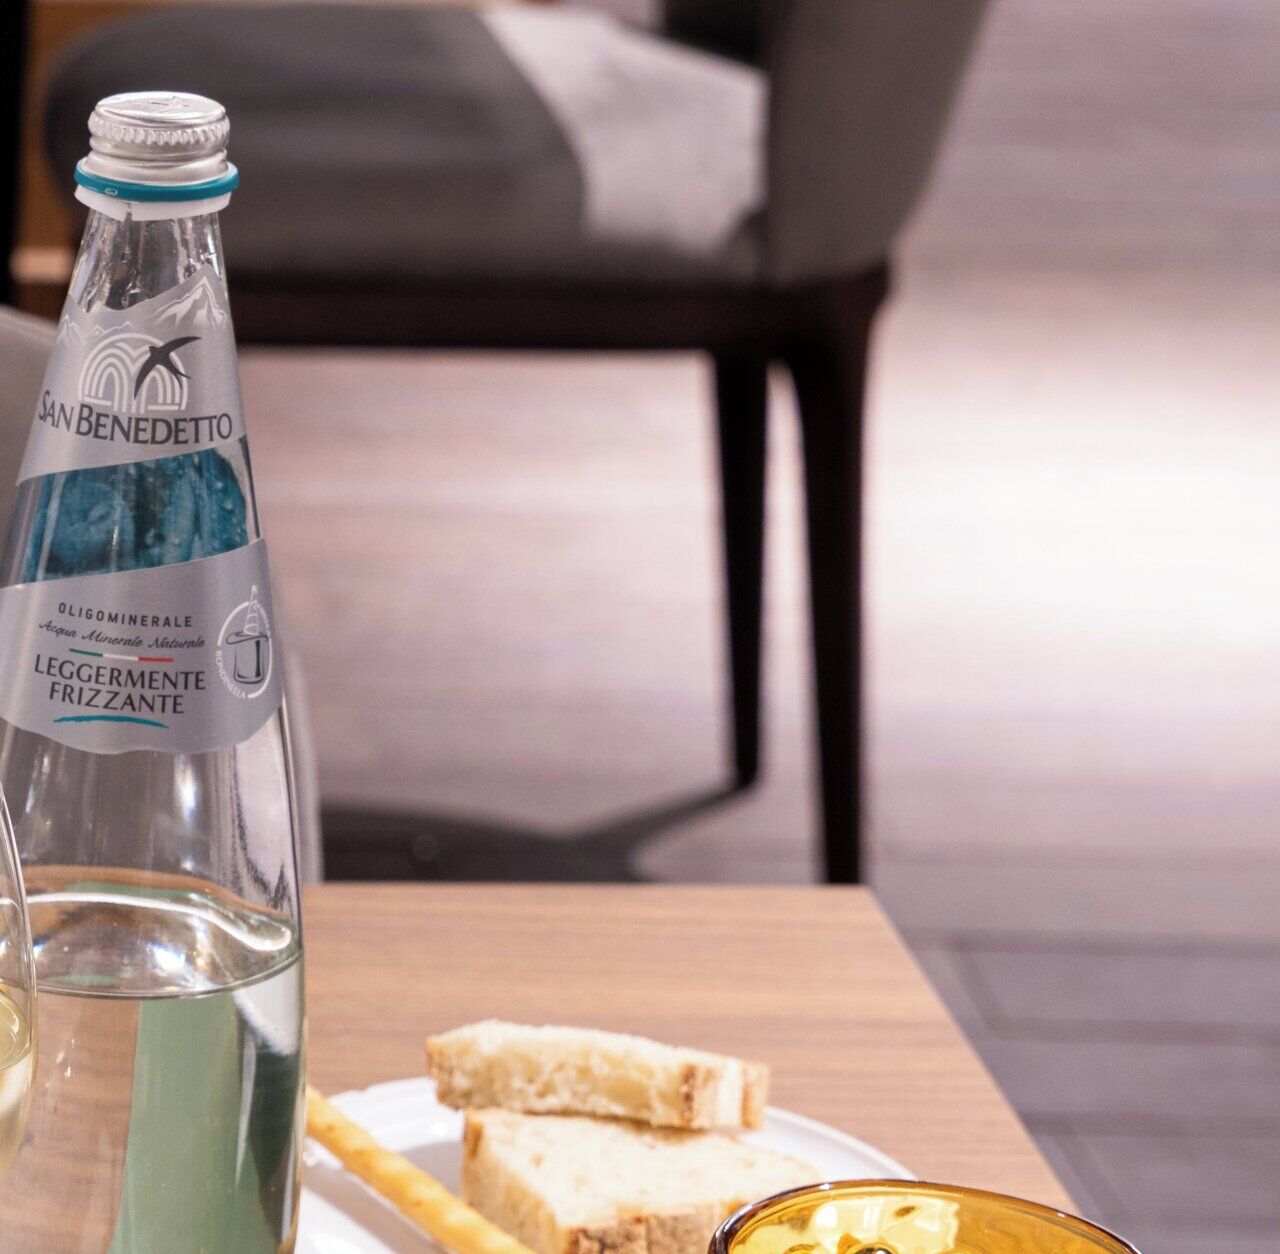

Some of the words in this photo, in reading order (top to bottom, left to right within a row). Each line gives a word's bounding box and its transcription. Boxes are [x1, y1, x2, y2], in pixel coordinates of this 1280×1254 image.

[38, 389, 75, 432] SAN
[75, 403, 233, 445] BENEDETTO
[58, 602, 193, 628] OLIGOMINERALE
[39, 620, 78, 638] Acqua
[81, 630, 143, 648] Minerale
[147, 635, 206, 650] Naturale
[34, 654, 206, 690] LEGGERMENTE
[49, 681, 184, 714] FRIZZANTE
